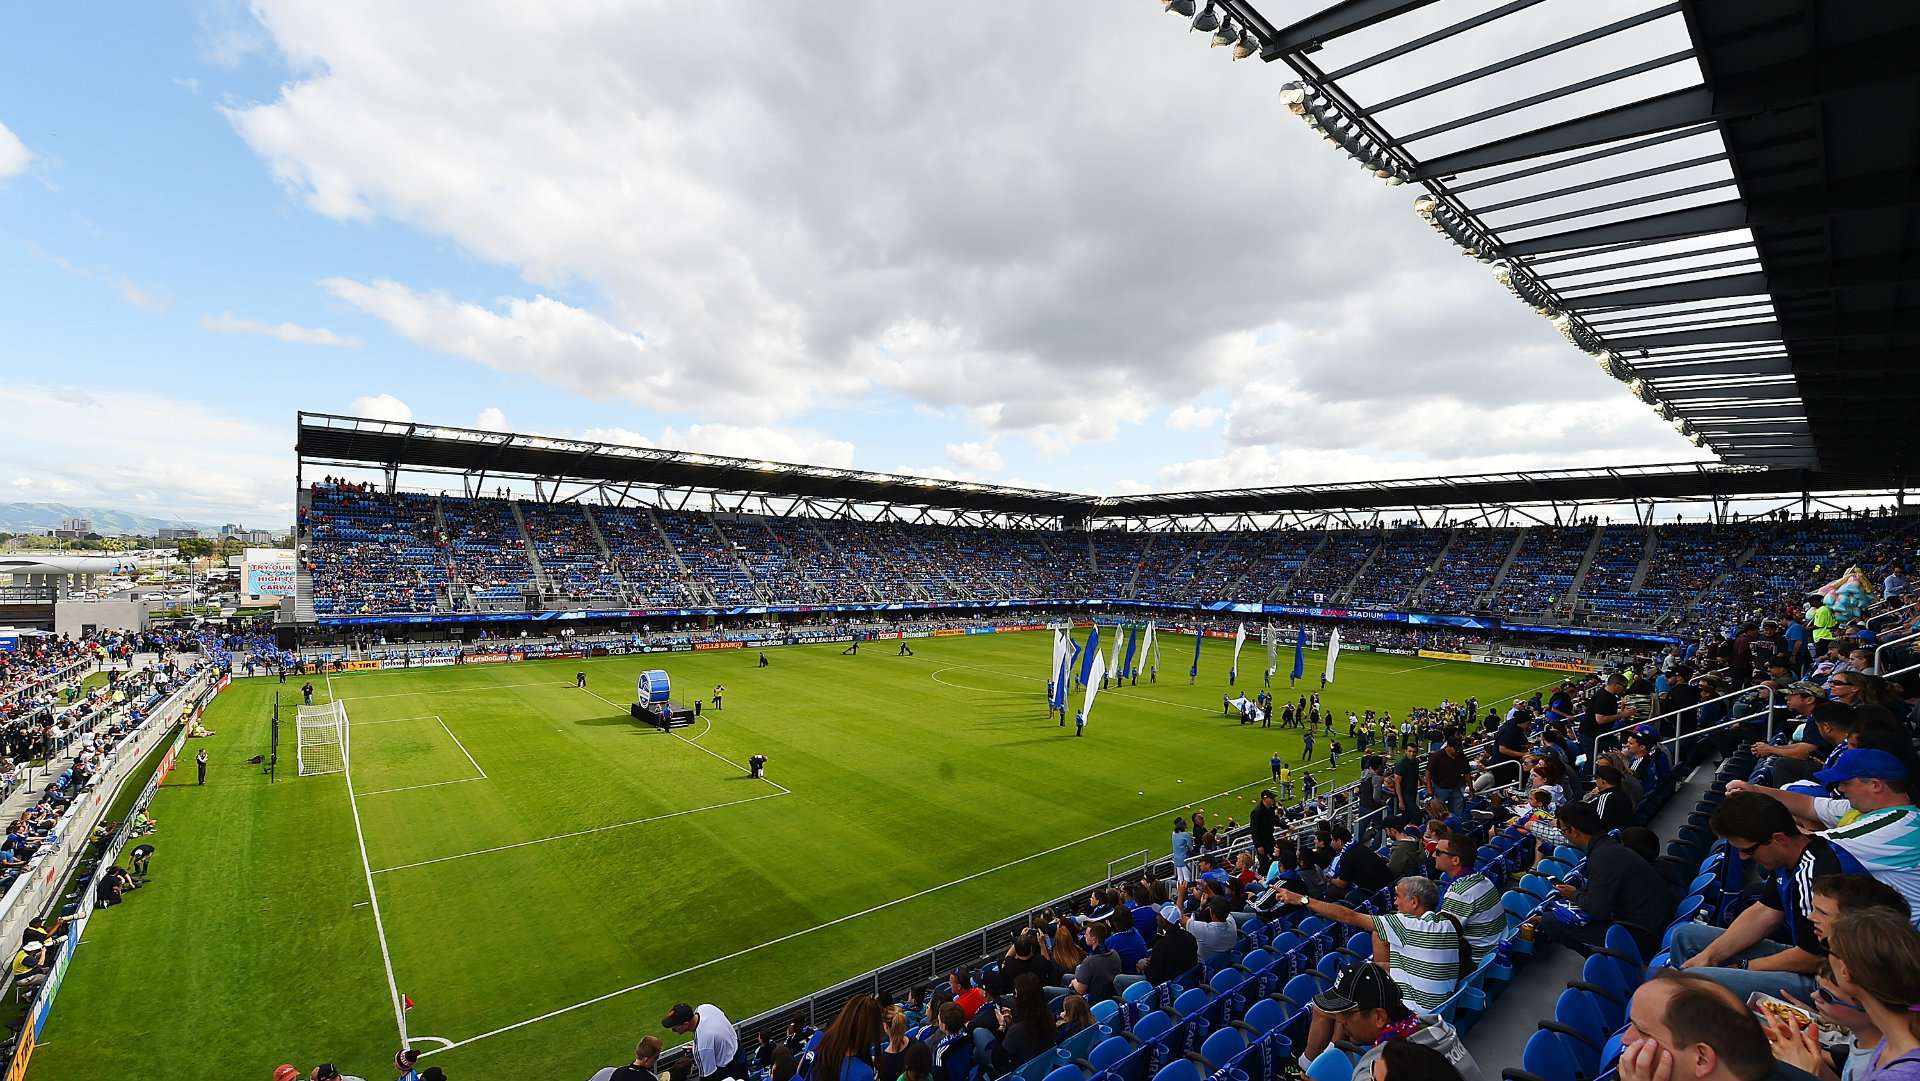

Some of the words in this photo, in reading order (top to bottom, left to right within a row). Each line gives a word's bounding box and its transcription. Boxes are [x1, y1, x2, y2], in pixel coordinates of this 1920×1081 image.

[1347, 610, 1383, 619] STADIUM
[902, 630, 929, 638] Heineken
[720, 641, 743, 649] FARGO
[761, 639, 783, 647] adidas
[466, 653, 522, 662] #LetsDoGamDay
[1531, 660, 1567, 669] Continental
